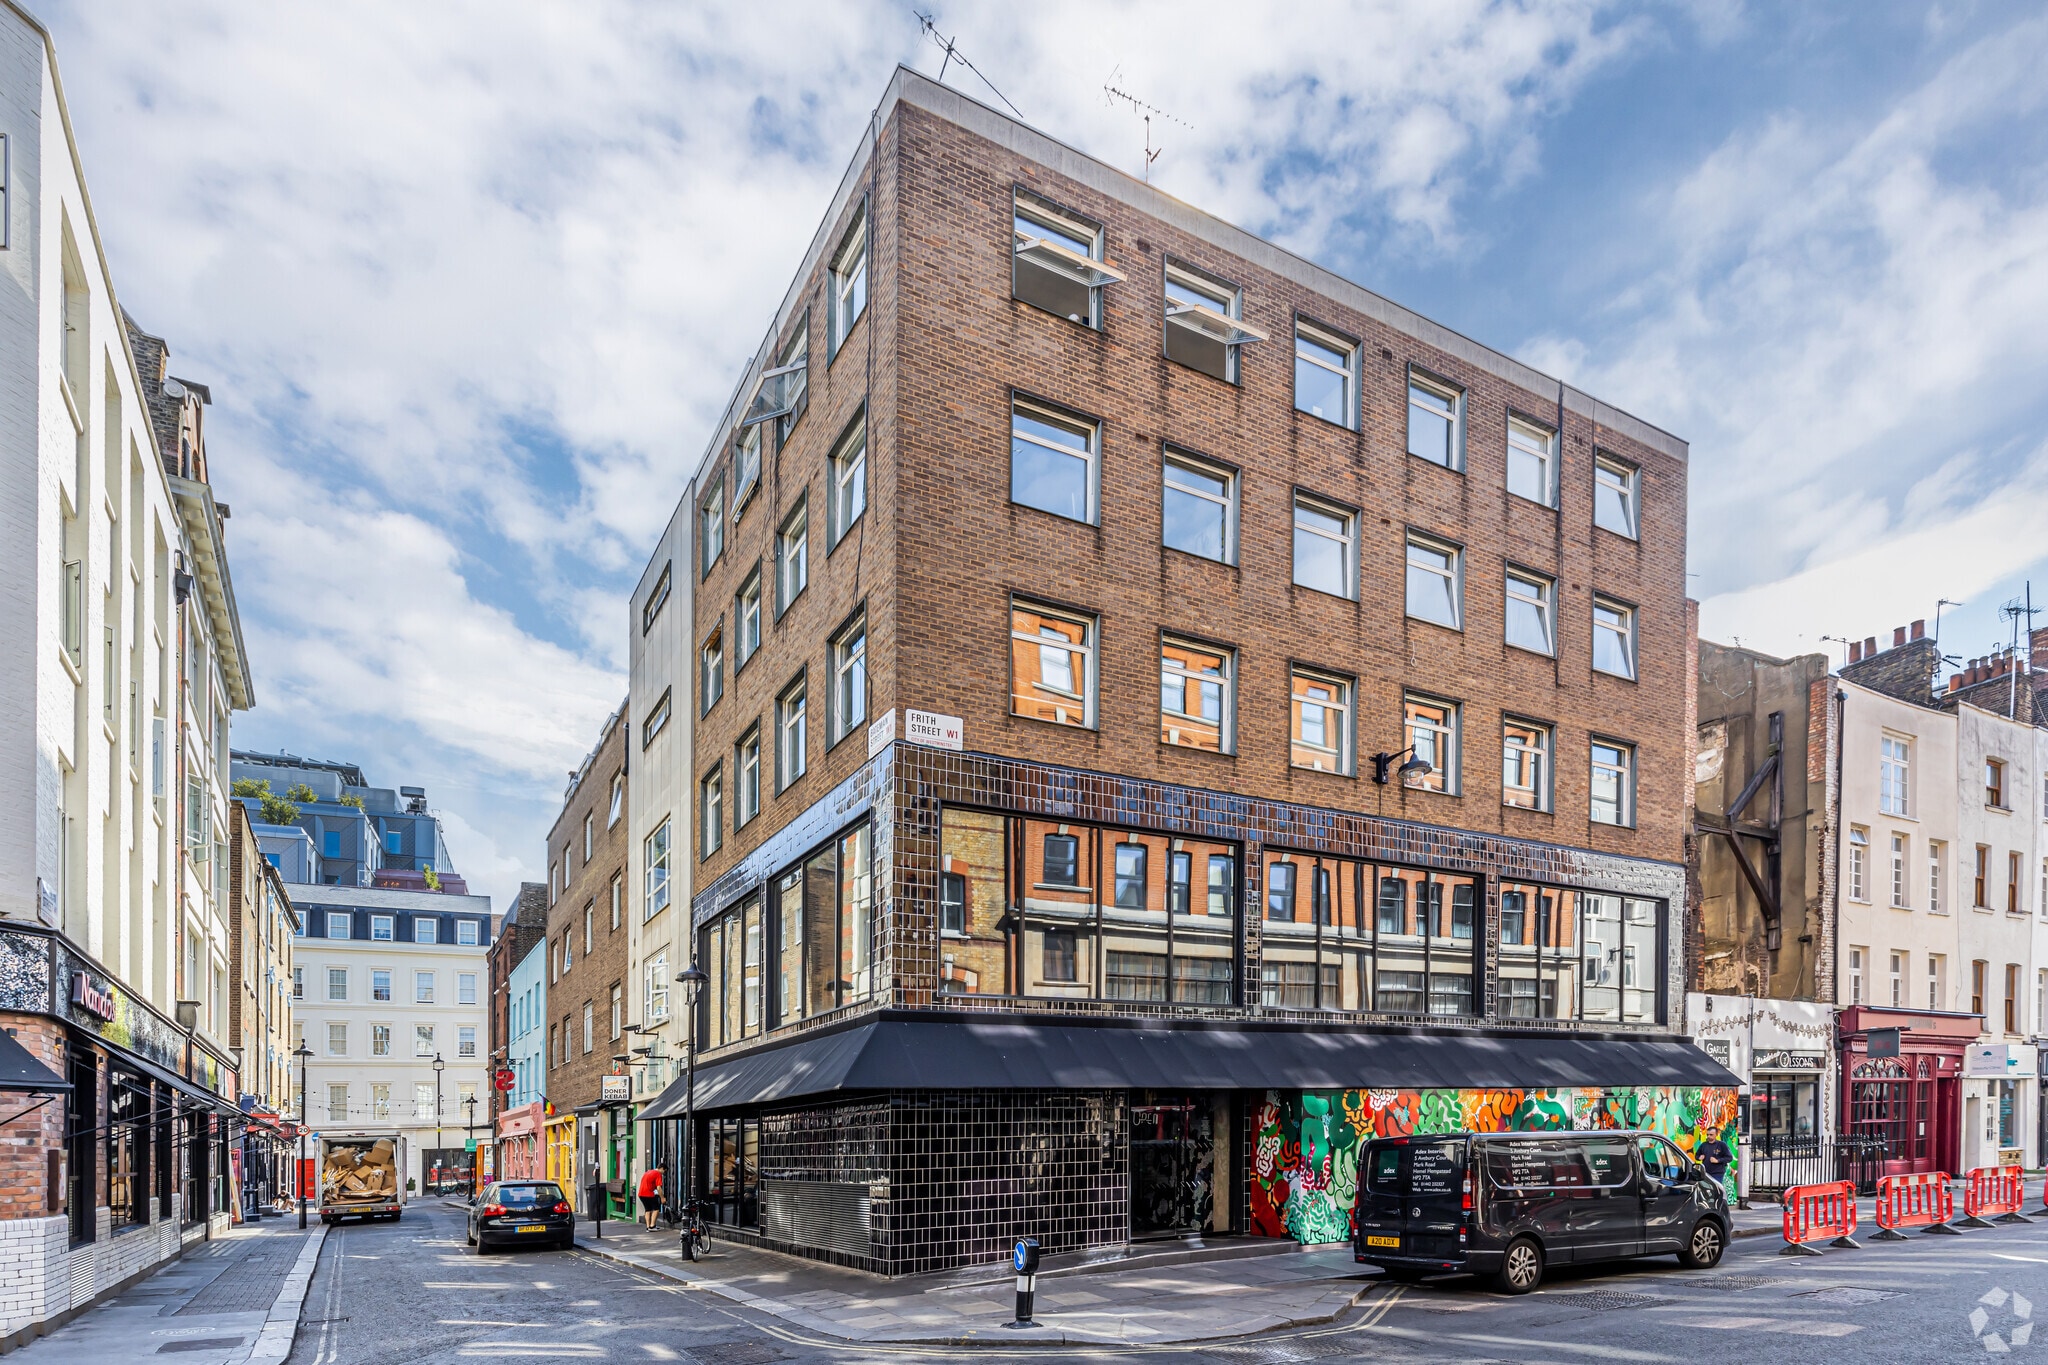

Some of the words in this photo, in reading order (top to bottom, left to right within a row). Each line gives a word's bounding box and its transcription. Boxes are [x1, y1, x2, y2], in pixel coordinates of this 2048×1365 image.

[911, 713, 936, 725] FRITH
[911, 724, 941, 737] STREET
[946, 729, 958, 740] W1
[926, 739, 952, 748] WESTMINSTER
[1706, 1043, 1728, 1055] GARLIC
